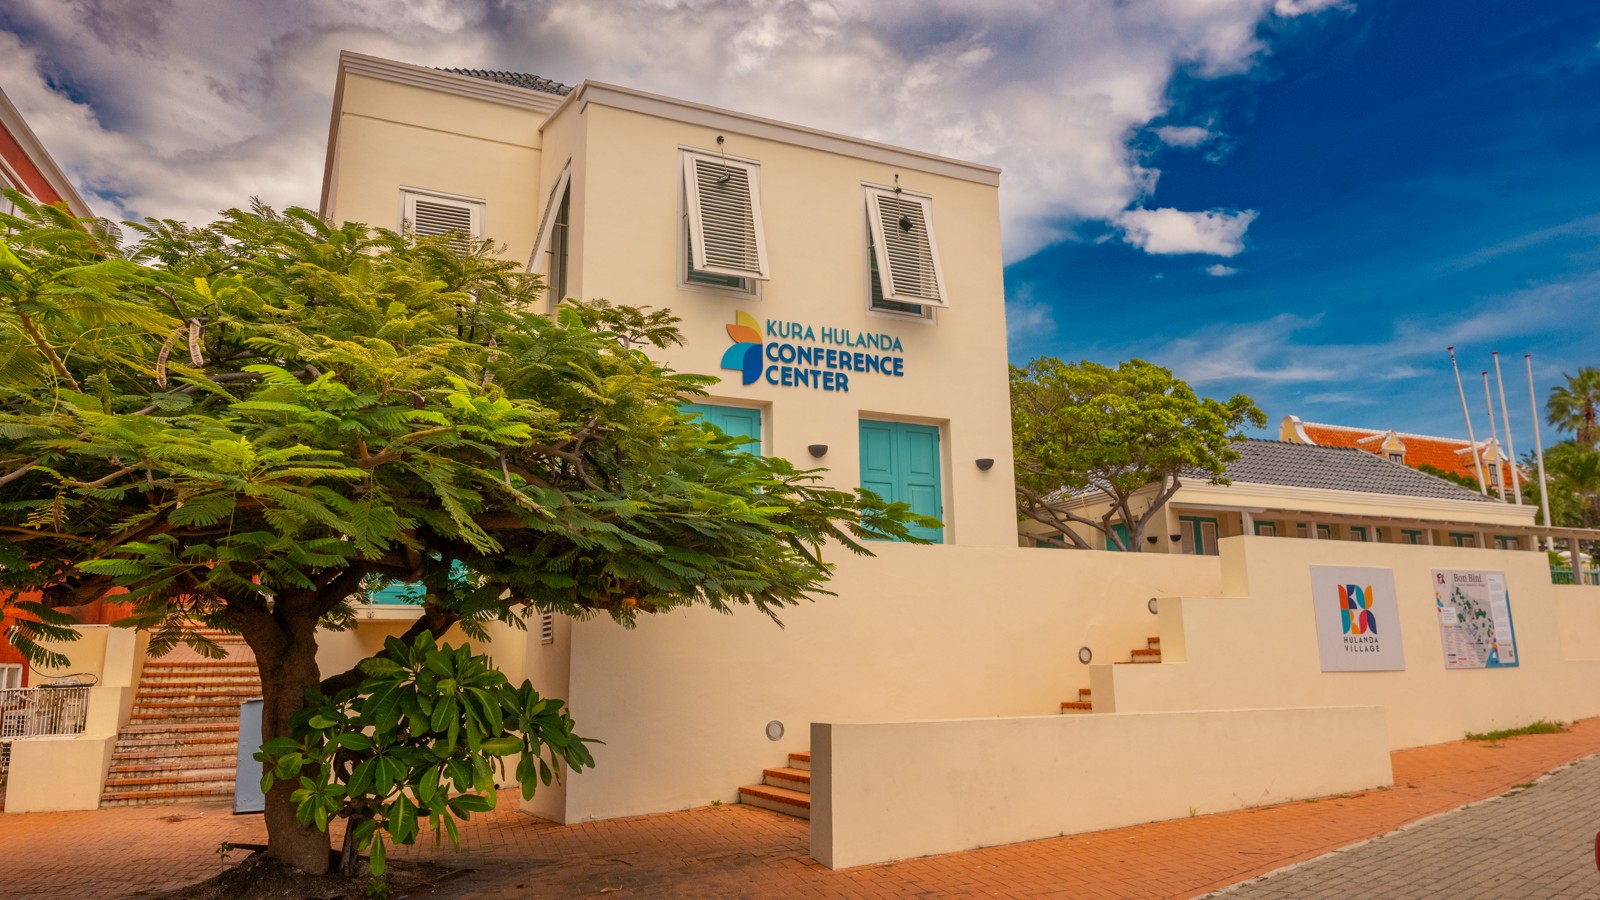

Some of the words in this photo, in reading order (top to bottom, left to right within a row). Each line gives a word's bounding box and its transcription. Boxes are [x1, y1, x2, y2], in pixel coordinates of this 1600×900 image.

[766, 319, 816, 342] KURA
[821, 326, 904, 353] HULANDA
[765, 342, 904, 377] CONFERENCE
[765, 365, 849, 393] CENTER
[1453, 573, 1467, 583] Bon
[1468, 573, 1482, 583] Bini
[1343, 636, 1378, 644] HULANDA
